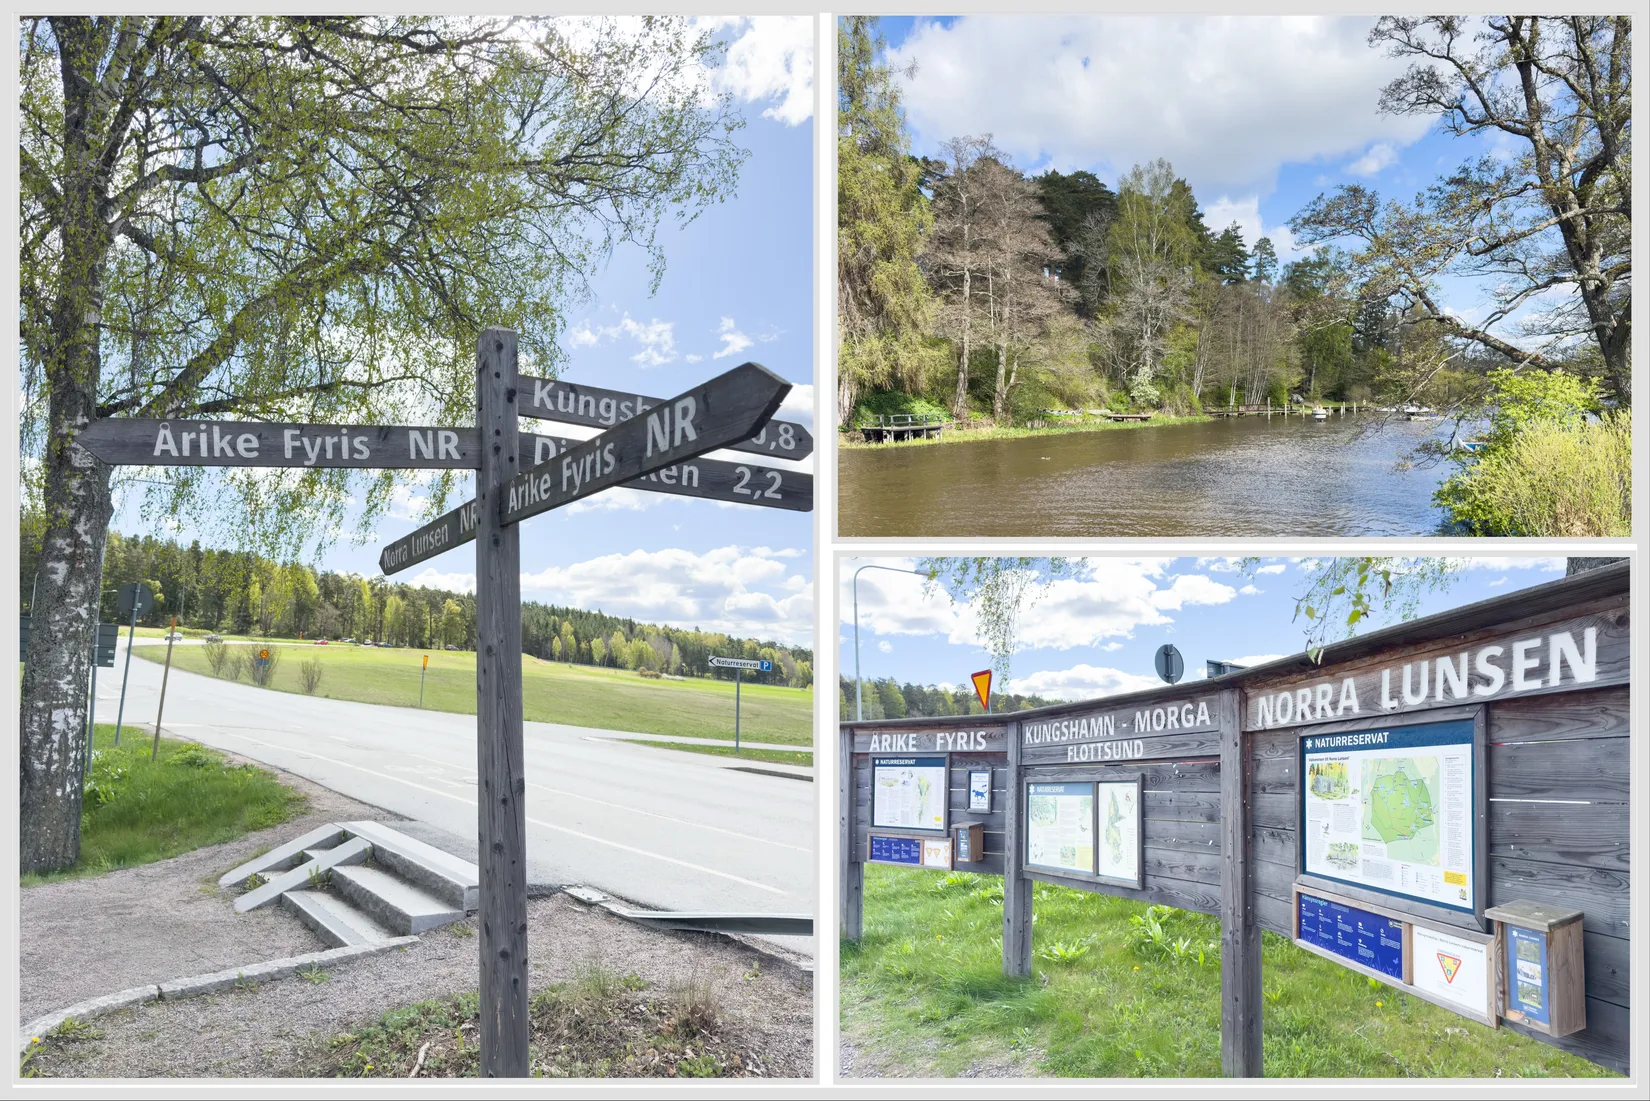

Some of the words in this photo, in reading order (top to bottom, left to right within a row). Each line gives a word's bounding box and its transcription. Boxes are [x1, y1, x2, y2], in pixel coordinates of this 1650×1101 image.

[533, 379, 652, 425] Kungsh
[153, 422, 260, 458] Årike
[283, 428, 371, 466] Fyris
[408, 430, 462, 460] NR
[507, 472, 551, 514] Årike
[561, 438, 616, 496] Fyris
[646, 396, 698, 458] NR
[733, 466, 783, 500] 2,2
[383, 544, 408, 569] Norra
[411, 523, 449, 557] Lunsen
[716, 659, 759, 668] Naturreservat
[763, 661, 769, 669] P
[1257, 677, 1360, 727] NORRA
[1381, 627, 1598, 709] LUNSEN
[869, 731, 917, 752] ÅRIKE
[936, 731, 987, 751] FYRIS
[1025, 715, 1115, 744] KUNGSHAMN
[1134, 702, 1211, 733] MORGA
[1315, 732, 1389, 748] NATURRESERVAT
[1067, 740, 1144, 762] FLOTTSUND
